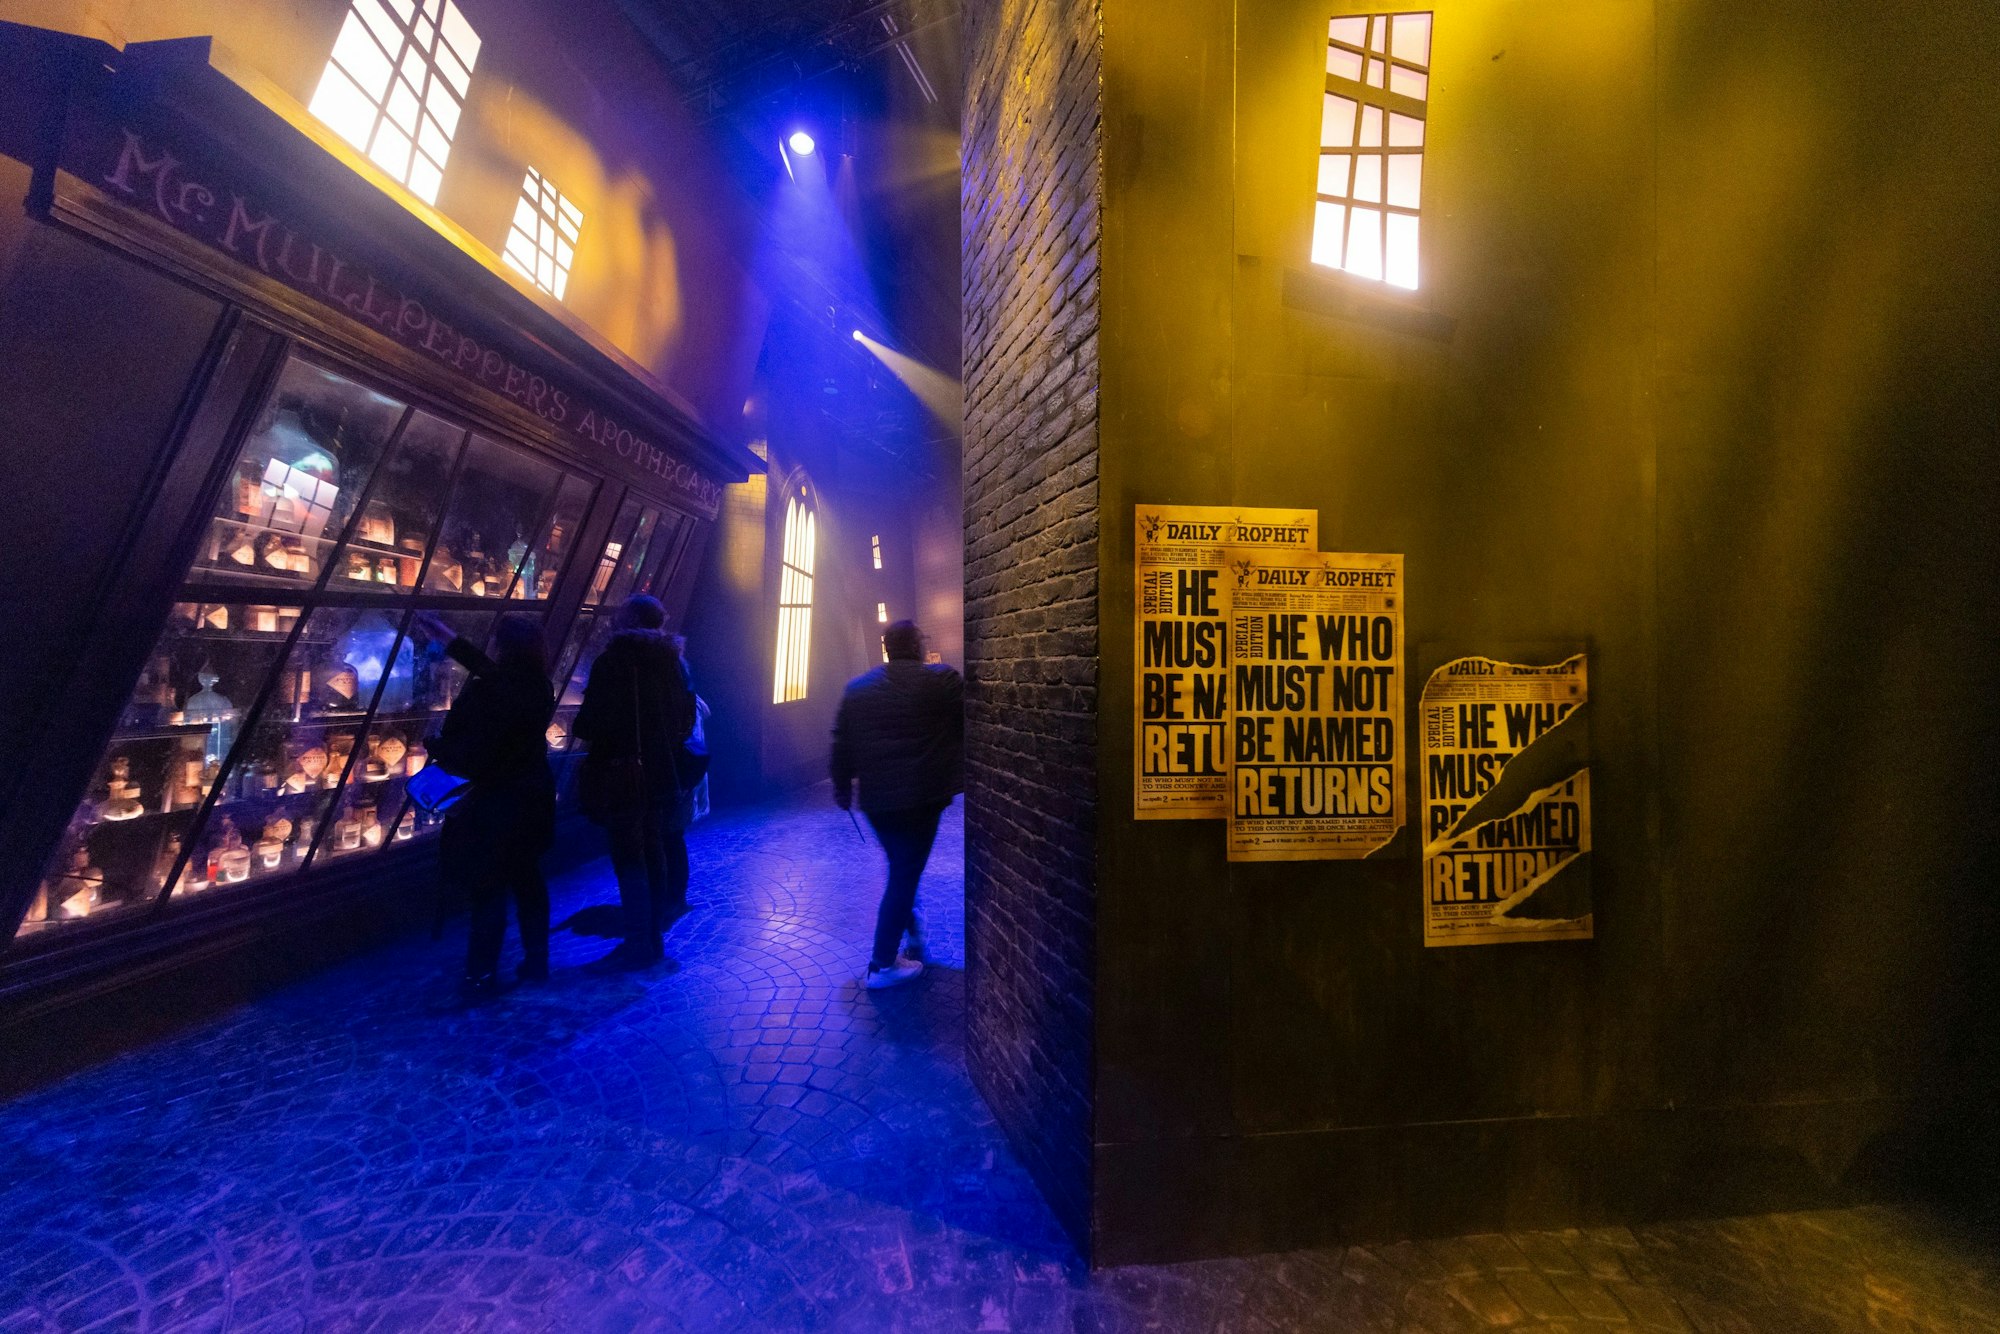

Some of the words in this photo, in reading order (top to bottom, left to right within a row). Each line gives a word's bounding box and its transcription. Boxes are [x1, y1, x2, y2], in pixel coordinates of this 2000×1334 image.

[576, 408, 722, 507] APOTHECARY
[1167, 524, 1222, 541] DAILY
[1224, 524, 1309, 543] PROPHET
[1144, 571, 1158, 614] SPECIAL
[1159, 571, 1173, 614] EDITION
[1178, 569, 1219, 616] HE
[1257, 569, 1310, 585] DAILY
[1315, 570, 1396, 587] PROPHET
[1235, 616, 1248, 659] SPECIAL
[1250, 616, 1263, 658] EDITION
[1268, 614, 1308, 660] HE
[1316, 615, 1393, 661] WHO
[1235, 665, 1325, 712] MUST
[1333, 666, 1394, 712] NOT
[1448, 661, 1495, 675] DAILY
[1143, 673, 1184, 719] BE
[1235, 717, 1276, 763] BE
[1283, 717, 1394, 762] NAMED
[1428, 706, 1440, 748] SPECIAL
[1442, 706, 1454, 747] EDITION
[1459, 704, 1497, 748] HE
[1236, 767, 1391, 816] RETURNS
[1477, 802, 1580, 849] NAMED
